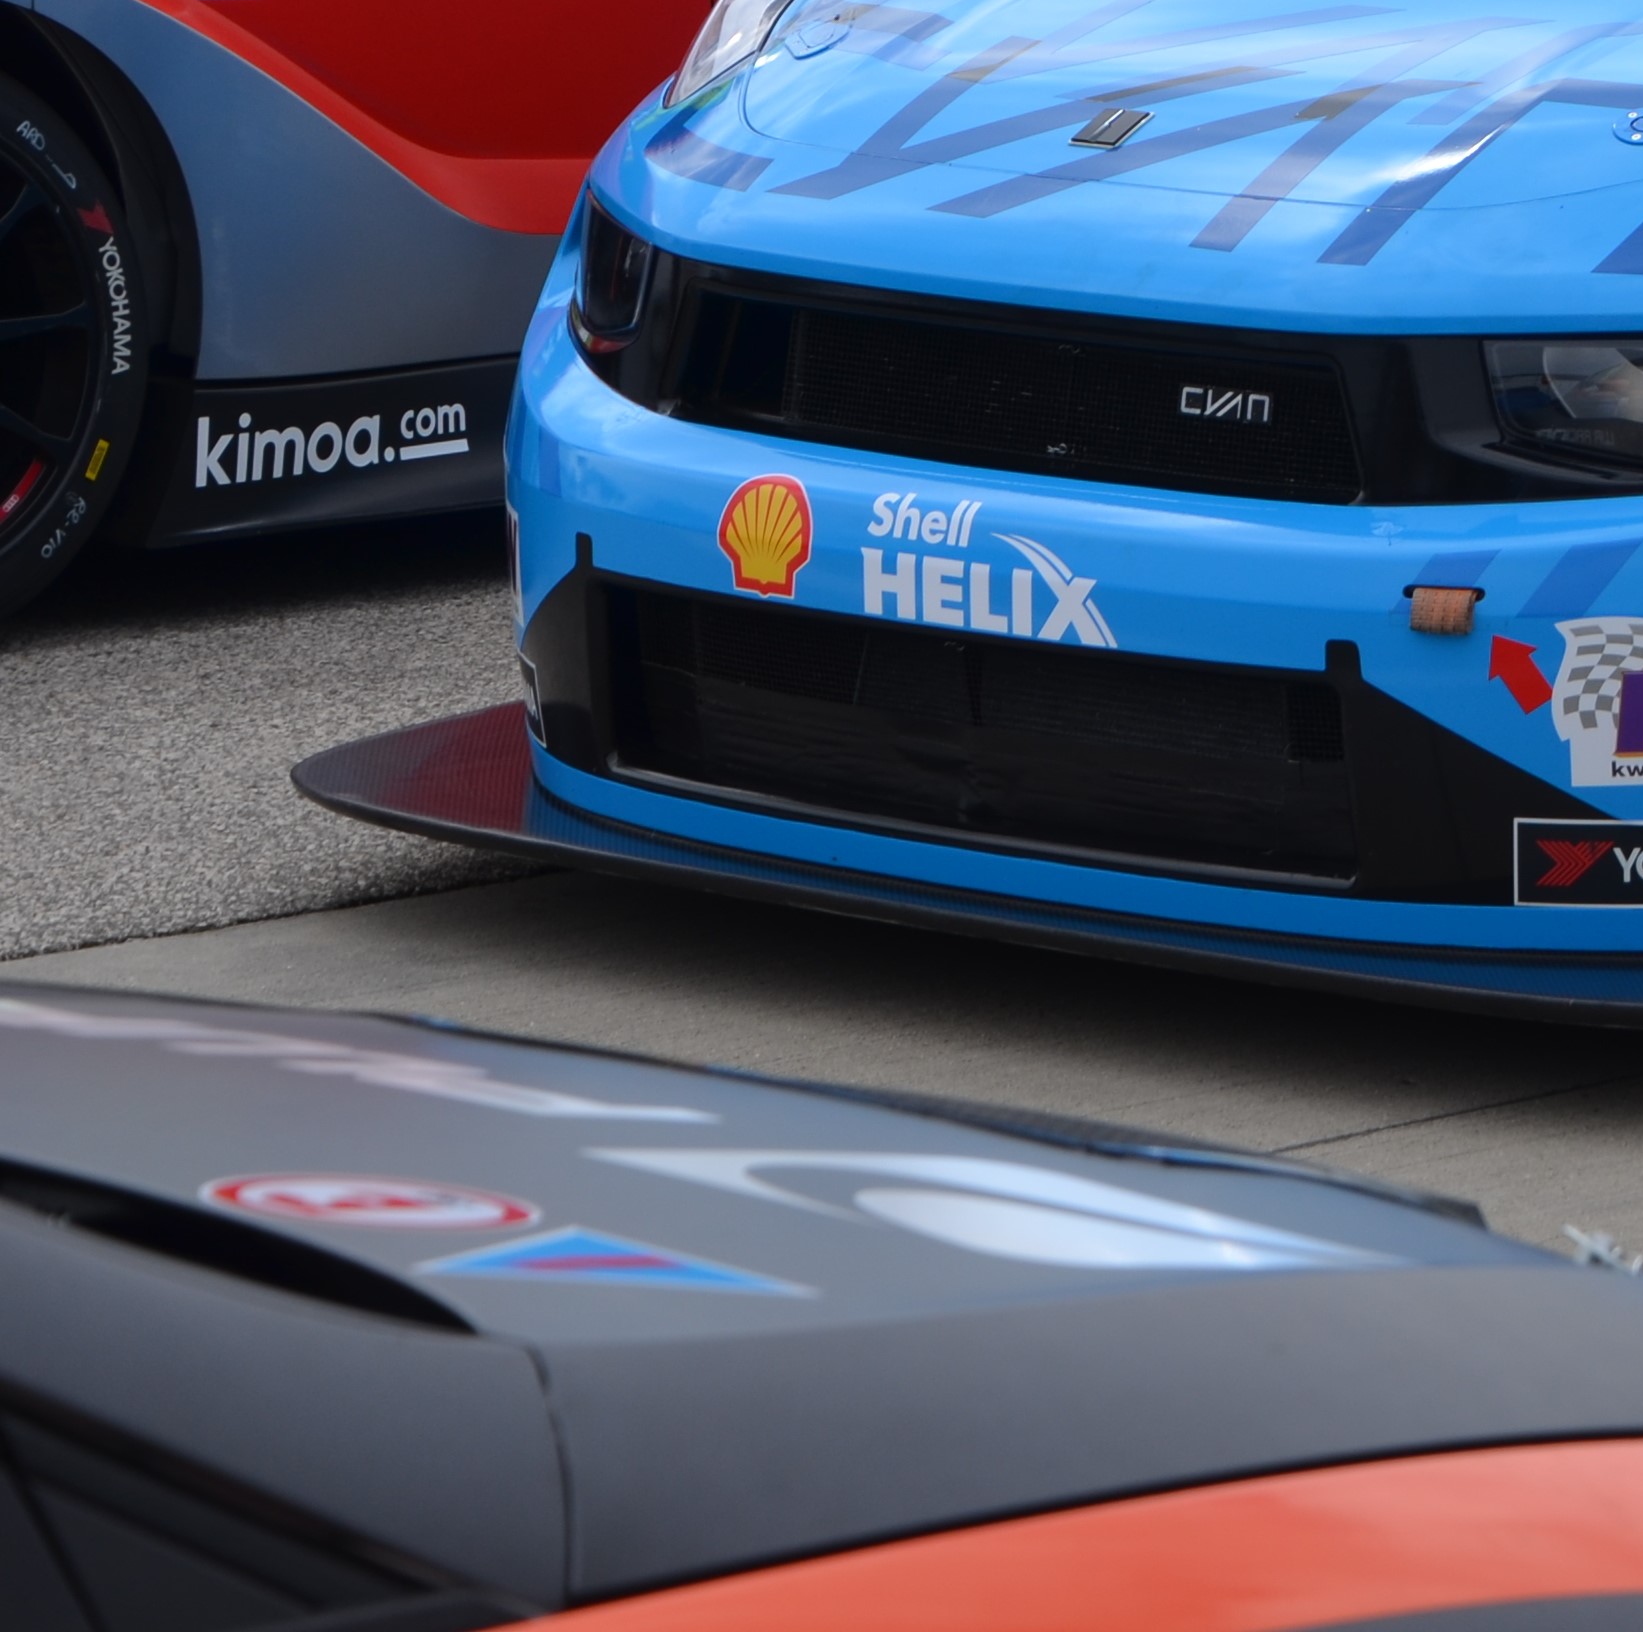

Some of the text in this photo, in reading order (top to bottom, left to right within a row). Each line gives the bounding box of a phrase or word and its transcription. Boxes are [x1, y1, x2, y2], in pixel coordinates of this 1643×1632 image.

[98, 236, 132, 375] YOKOHAMA
[866, 491, 982, 548] Shell
[860, 533, 1119, 649] HELIX
